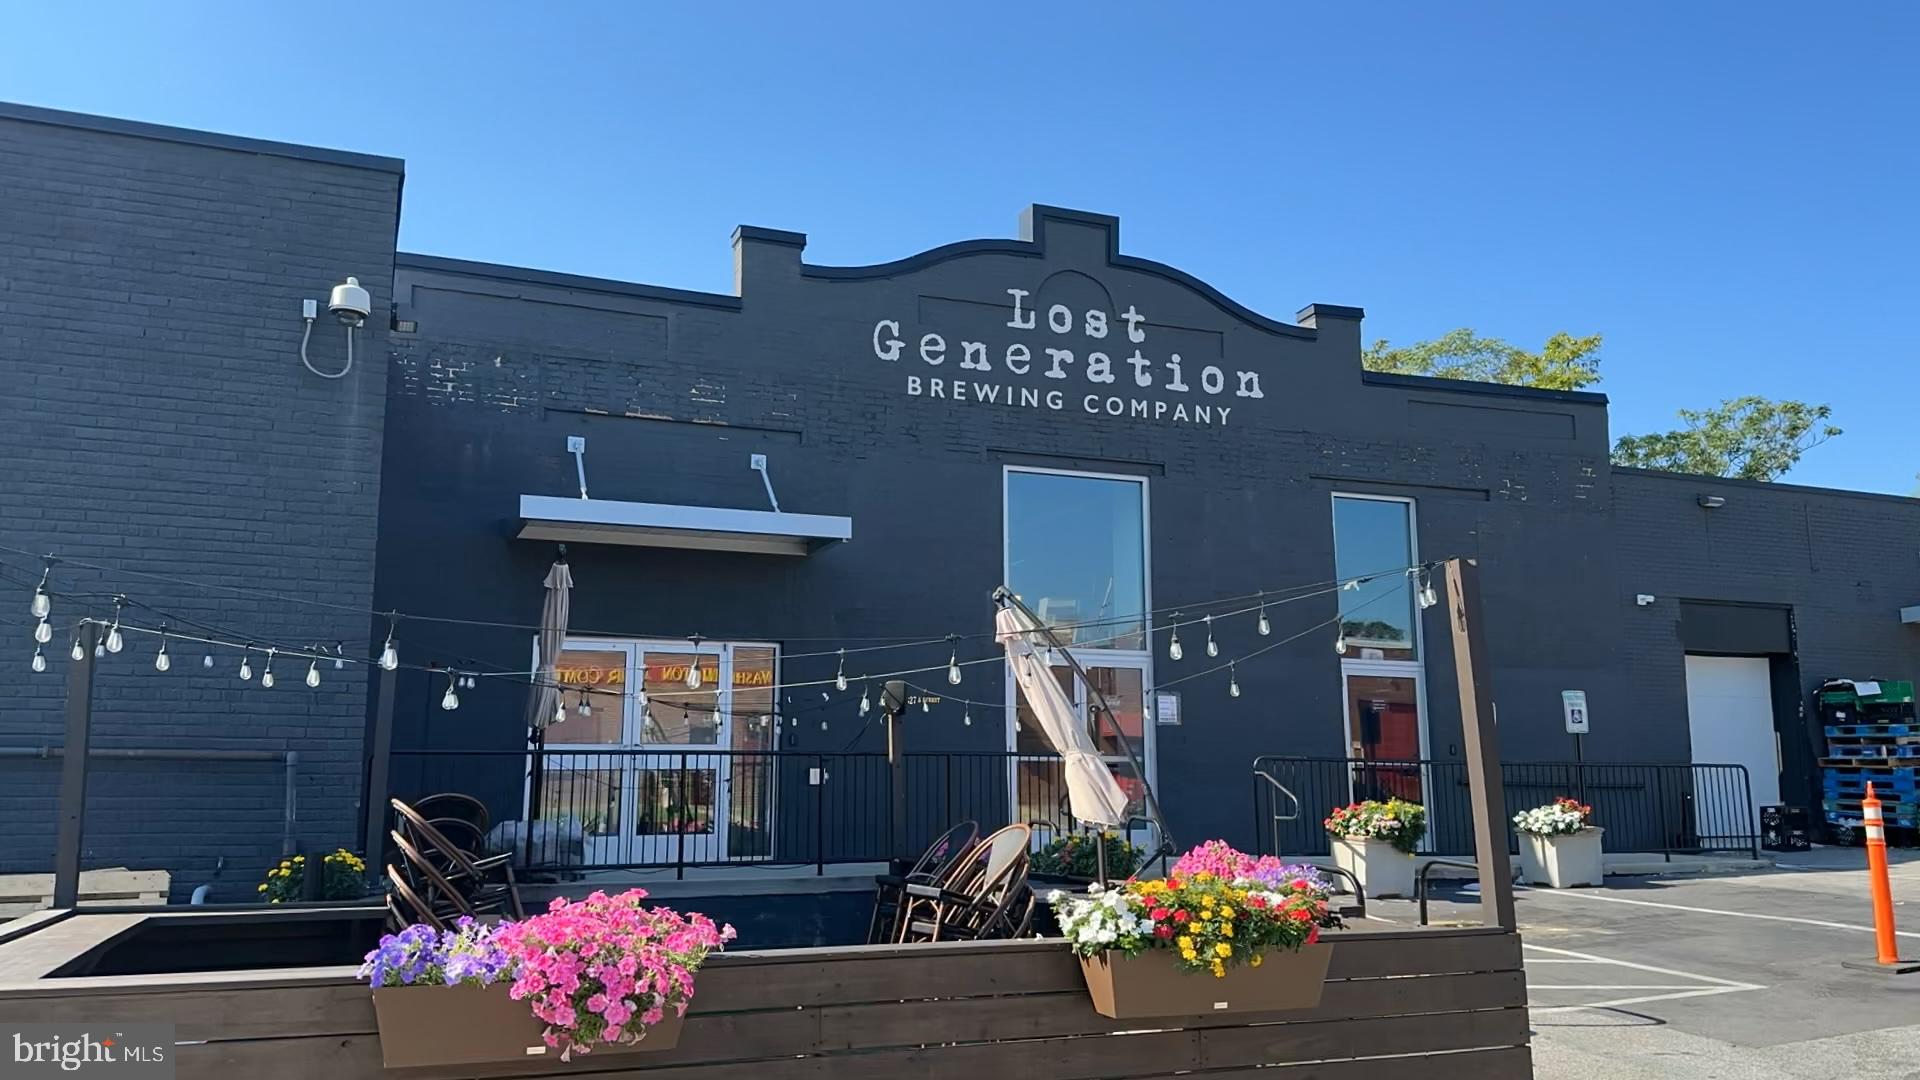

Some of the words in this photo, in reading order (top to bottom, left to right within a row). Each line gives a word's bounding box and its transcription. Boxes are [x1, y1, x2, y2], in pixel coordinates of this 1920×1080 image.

[1006, 288, 1146, 343] Lost
[873, 319, 1265, 399] Generation
[907, 375, 1064, 410] BREWING
[1083, 394, 1232, 425] COMPANY
